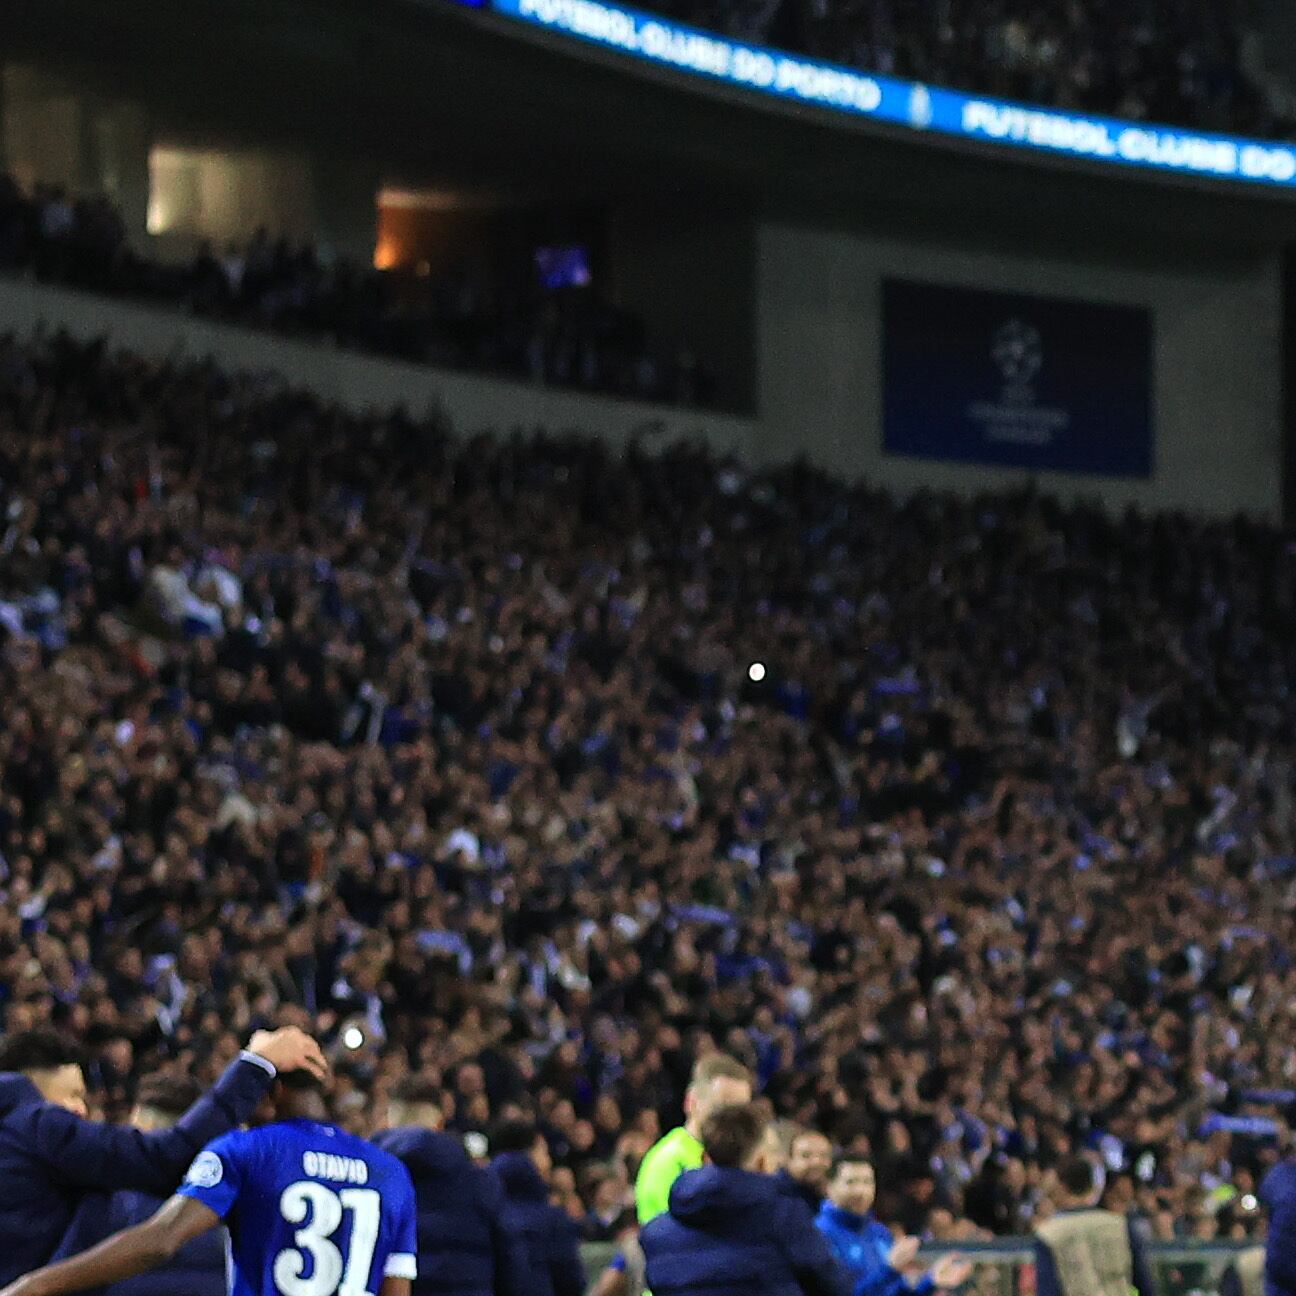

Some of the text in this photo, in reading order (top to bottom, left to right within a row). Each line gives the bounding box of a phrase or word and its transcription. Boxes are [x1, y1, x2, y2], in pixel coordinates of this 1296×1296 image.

[962, 101, 1115, 157] FUTEBOL
[1118, 128, 1237, 174] CLUBE
[1239, 146, 1296, 181] DO
